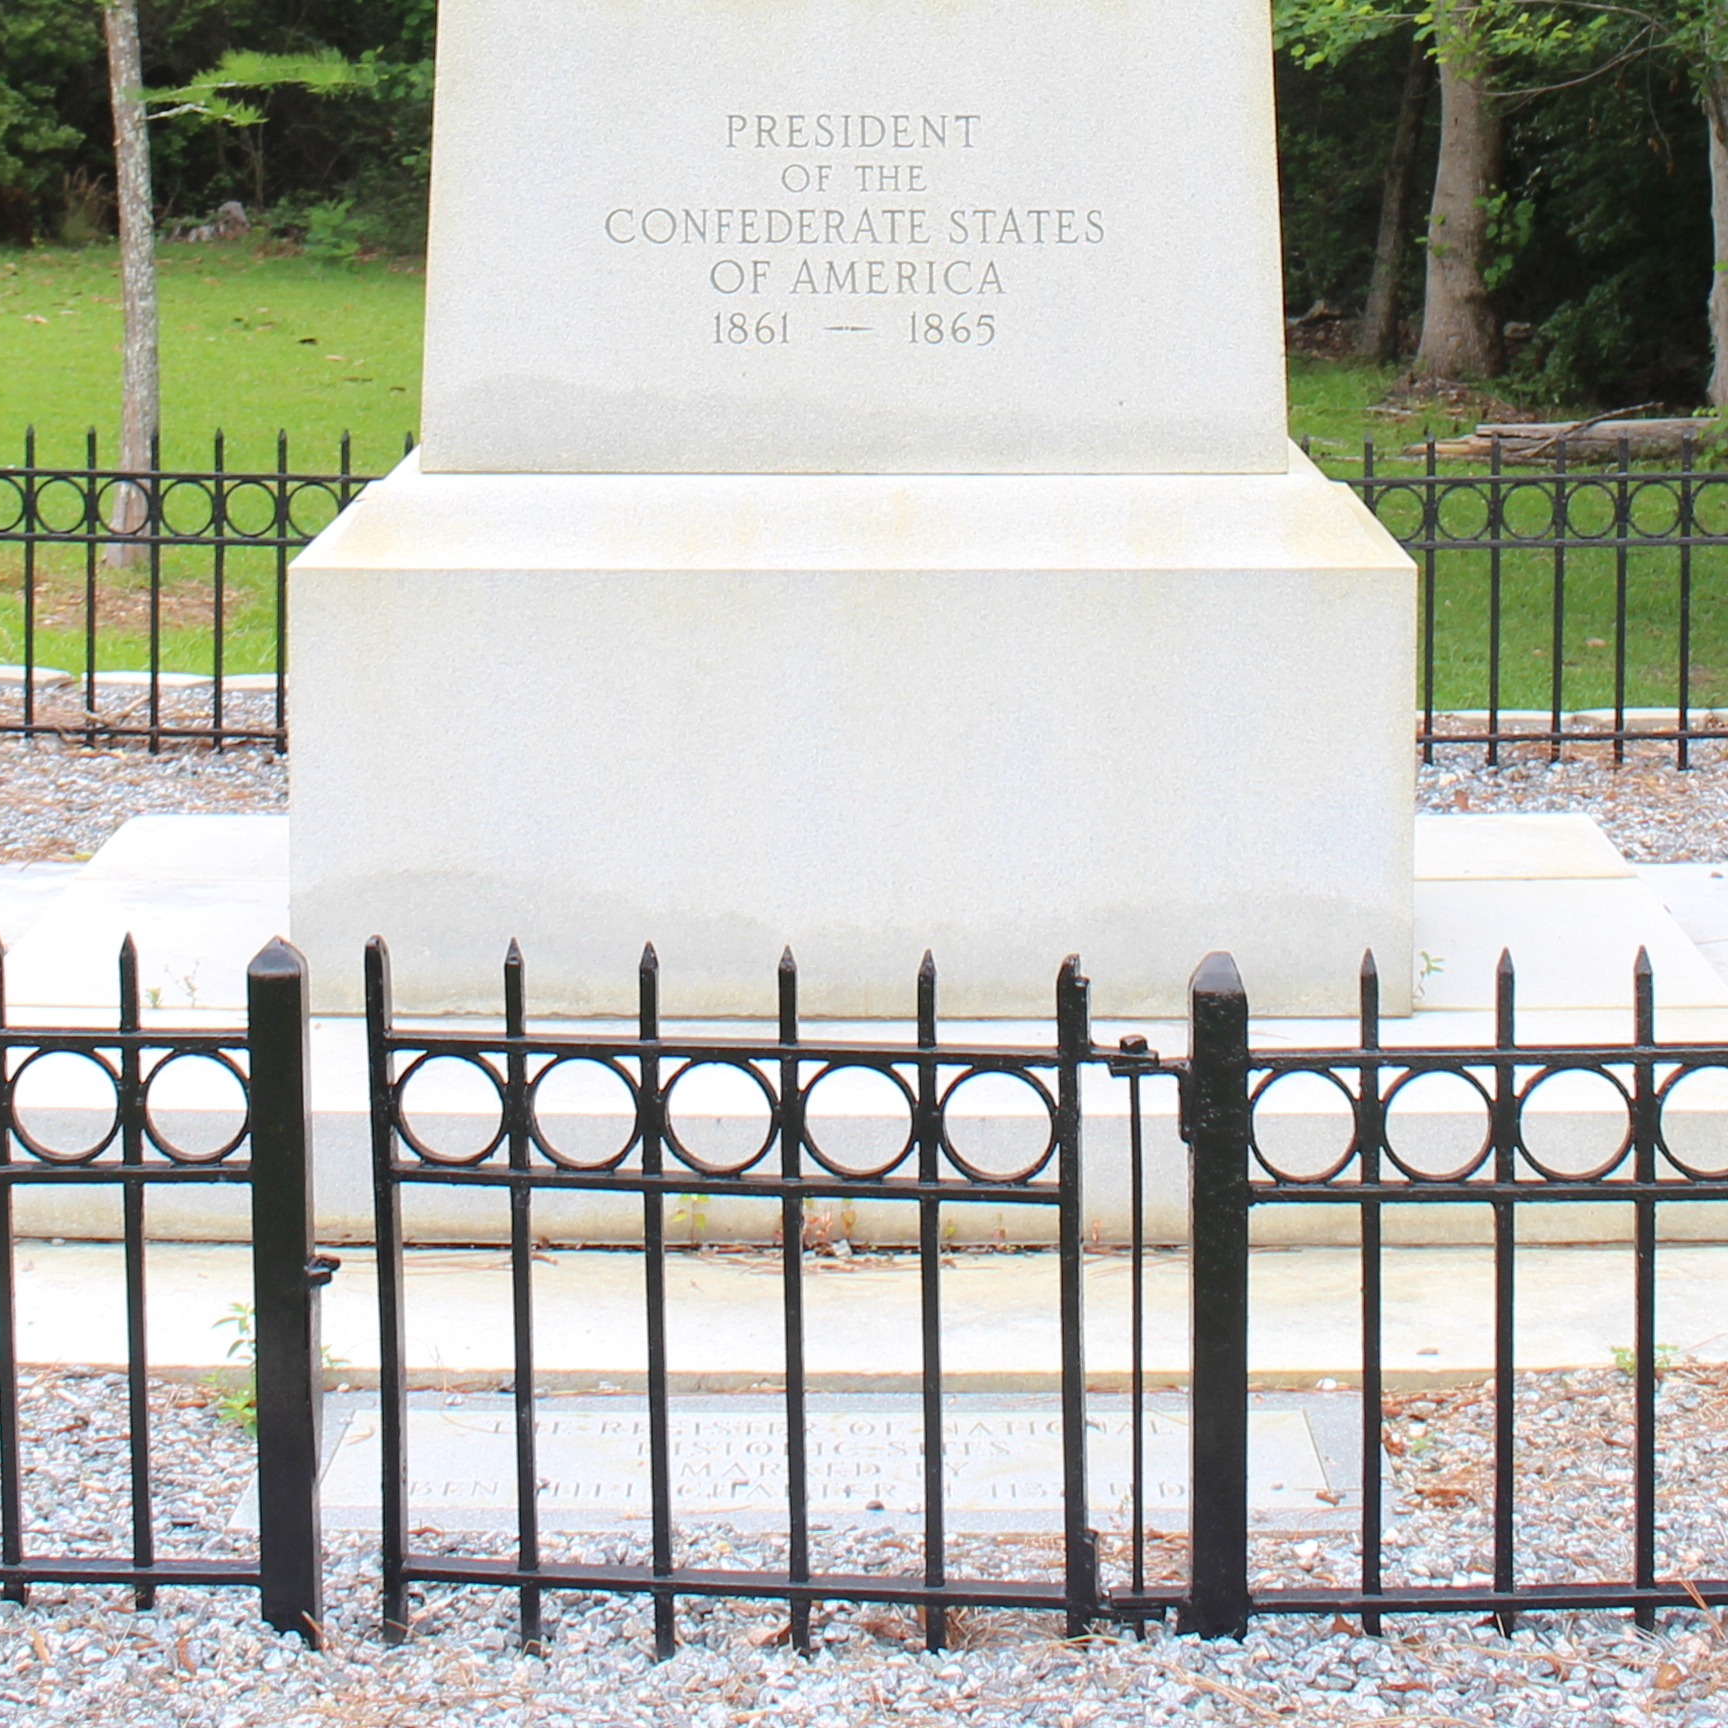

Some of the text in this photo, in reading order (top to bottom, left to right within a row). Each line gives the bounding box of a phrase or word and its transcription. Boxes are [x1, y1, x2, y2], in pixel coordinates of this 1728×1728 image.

[725, 114, 982, 149] PRESIDENT
[781, 164, 928, 193] OF THE
[604, 207, 1107, 245] CONFEDERATE STATES
[709, 258, 1007, 295] OF AMERICA
[712, 312, 791, 345] 1861
[907, 312, 997, 346] 1865
[409, 1480, 499, 1497] BEN
[676, 1481, 896, 1499] CHATER
